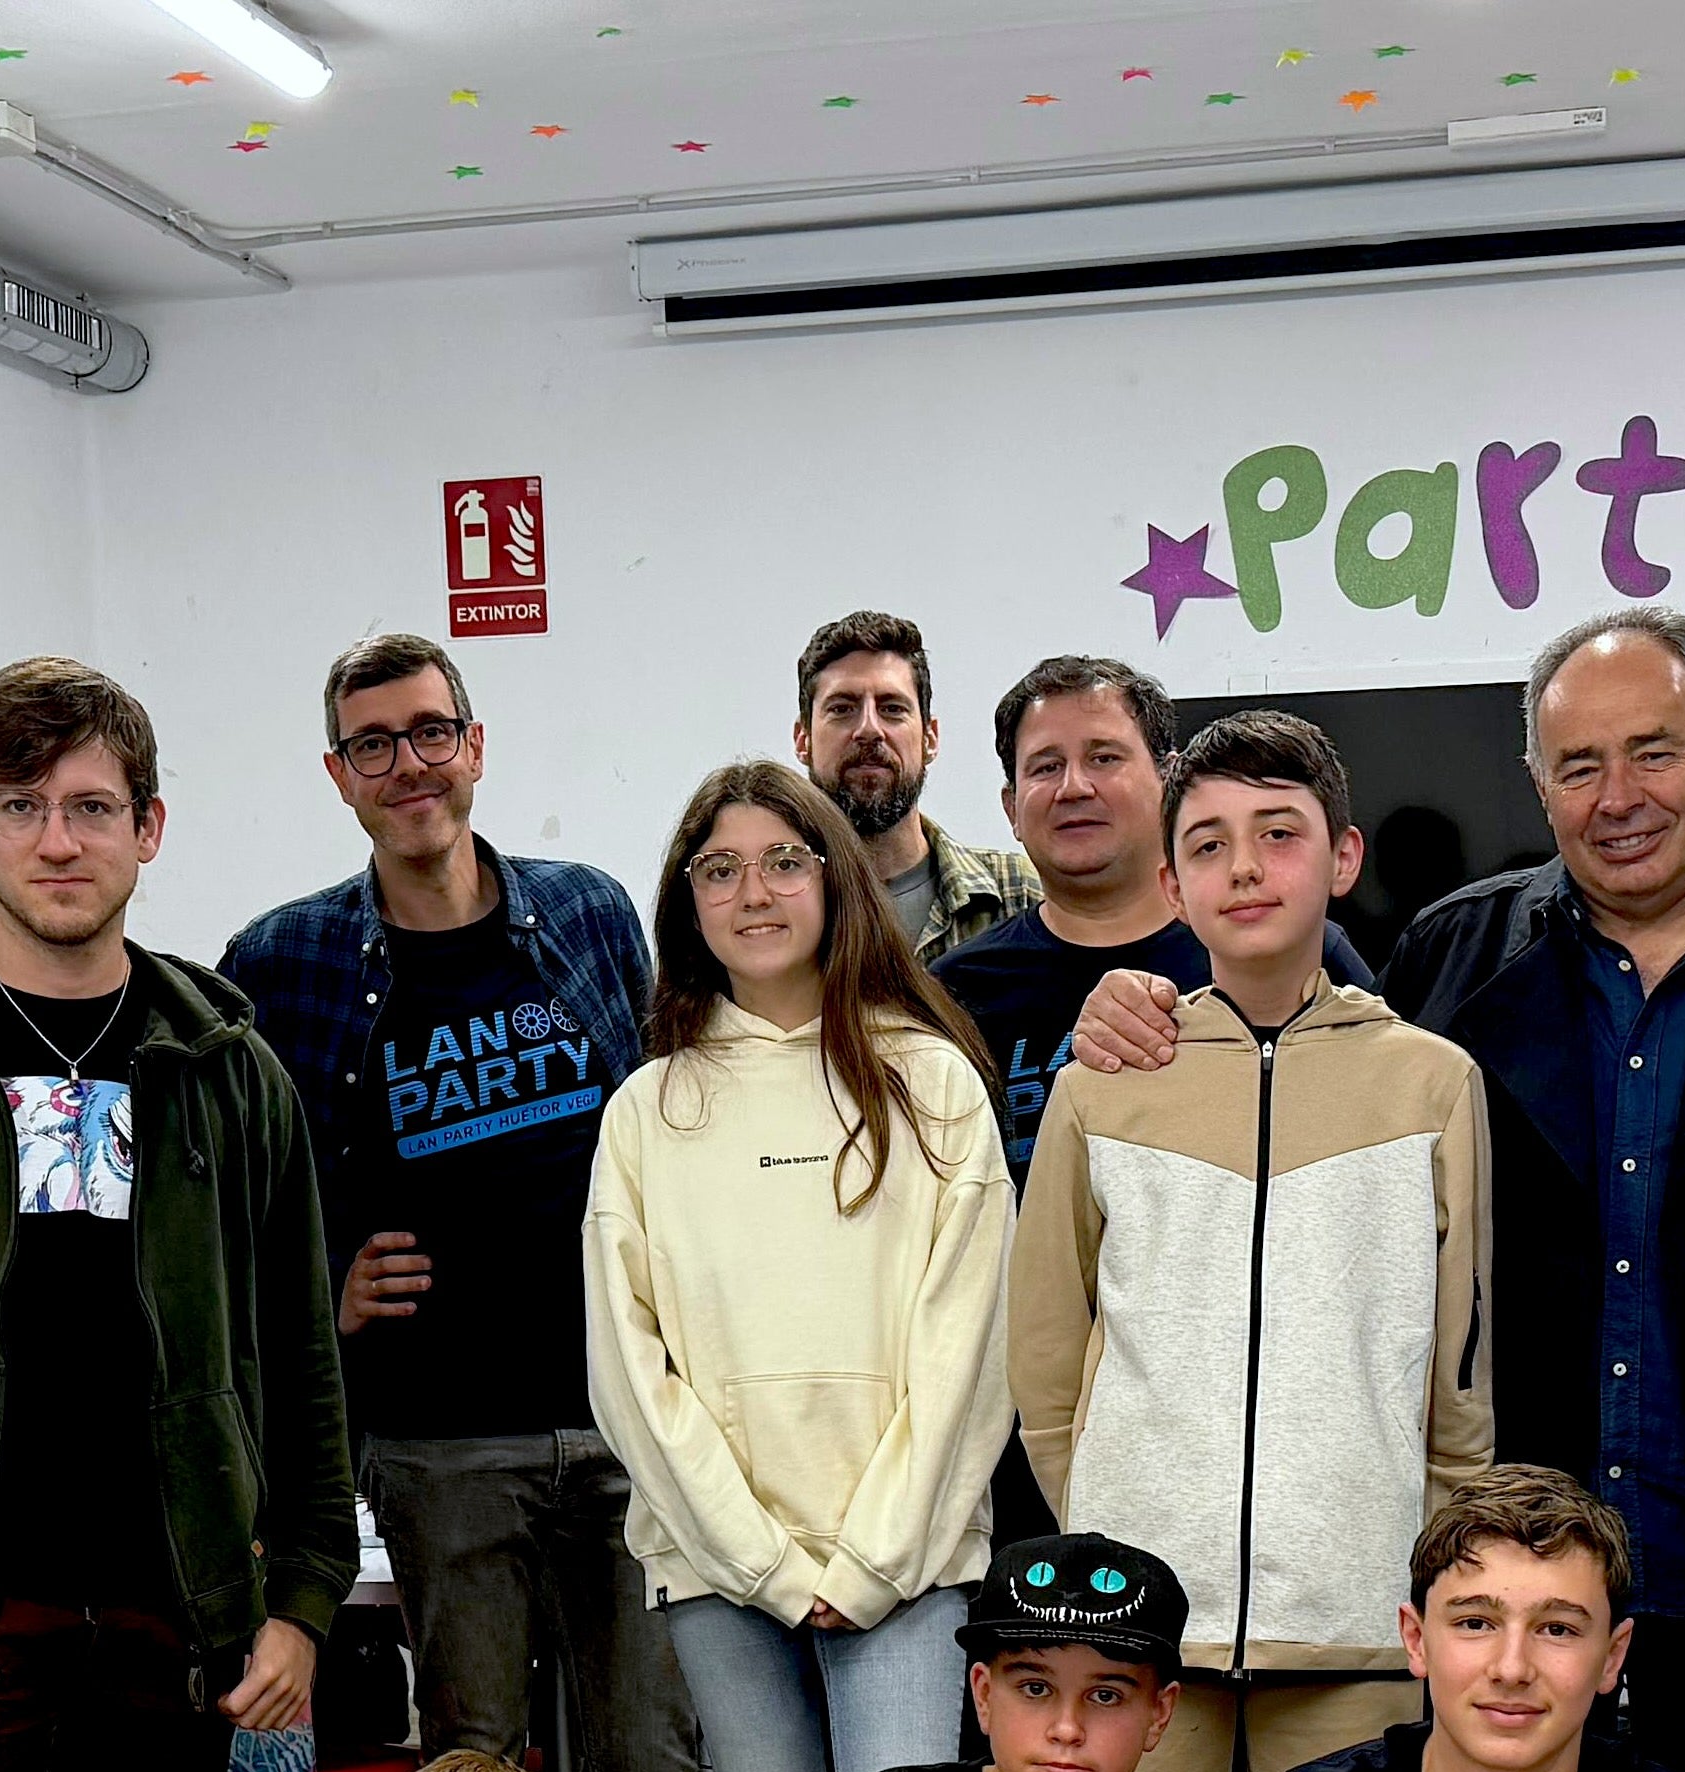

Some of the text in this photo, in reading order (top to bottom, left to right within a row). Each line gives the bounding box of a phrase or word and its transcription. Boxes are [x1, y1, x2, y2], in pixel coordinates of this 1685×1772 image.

[456, 603, 541, 622] EXTINTOR
[384, 1011, 508, 1081] LAN
[388, 1037, 590, 1131] PARTY
[407, 1136, 437, 1154] LAN
[443, 1120, 493, 1145] PARTY
